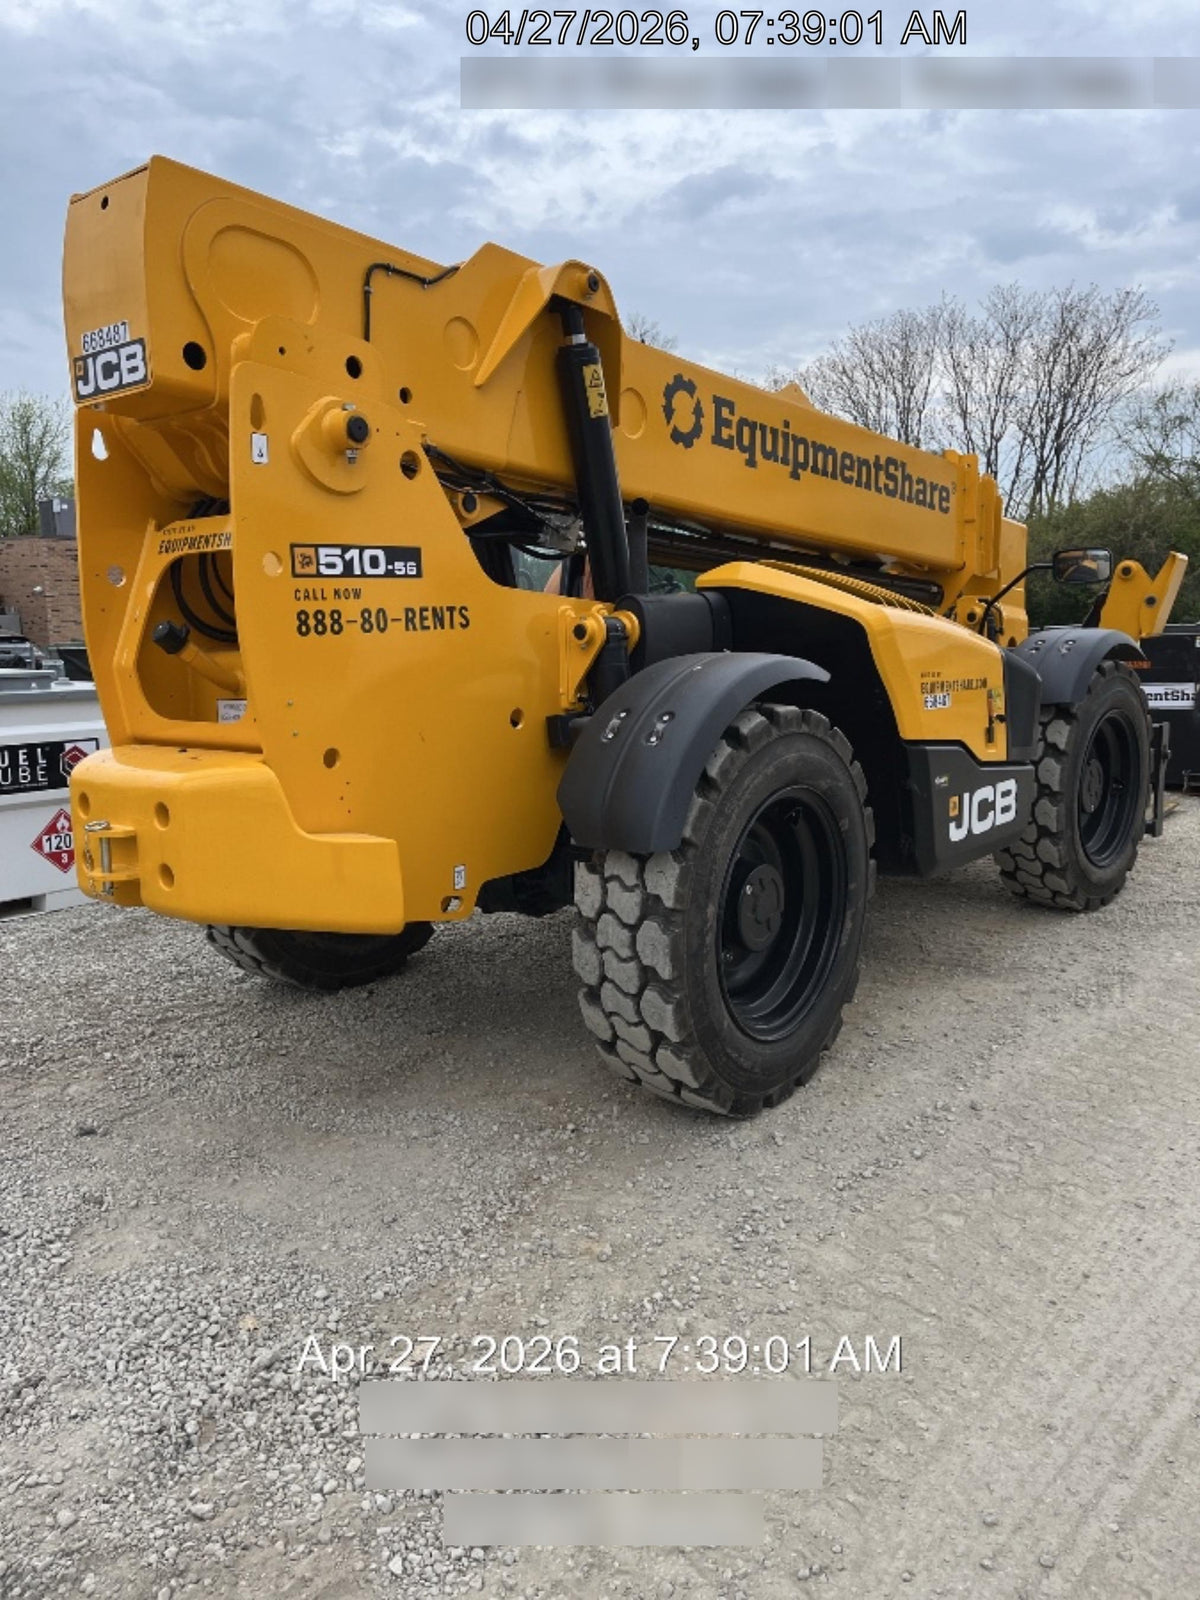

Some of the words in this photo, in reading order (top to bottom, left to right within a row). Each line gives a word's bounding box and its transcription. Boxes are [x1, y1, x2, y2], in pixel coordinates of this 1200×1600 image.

[82, 320, 129, 353] 668487
[77, 342, 146, 395] JCB
[711, 394, 951, 514] EquipmentShare
[294, 588, 327, 601] CALL
[333, 588, 362, 600] NOW
[296, 605, 470, 637] 888-80-RENTS
[948, 778, 1017, 842] JCB
[61, 852, 69, 864] 3
